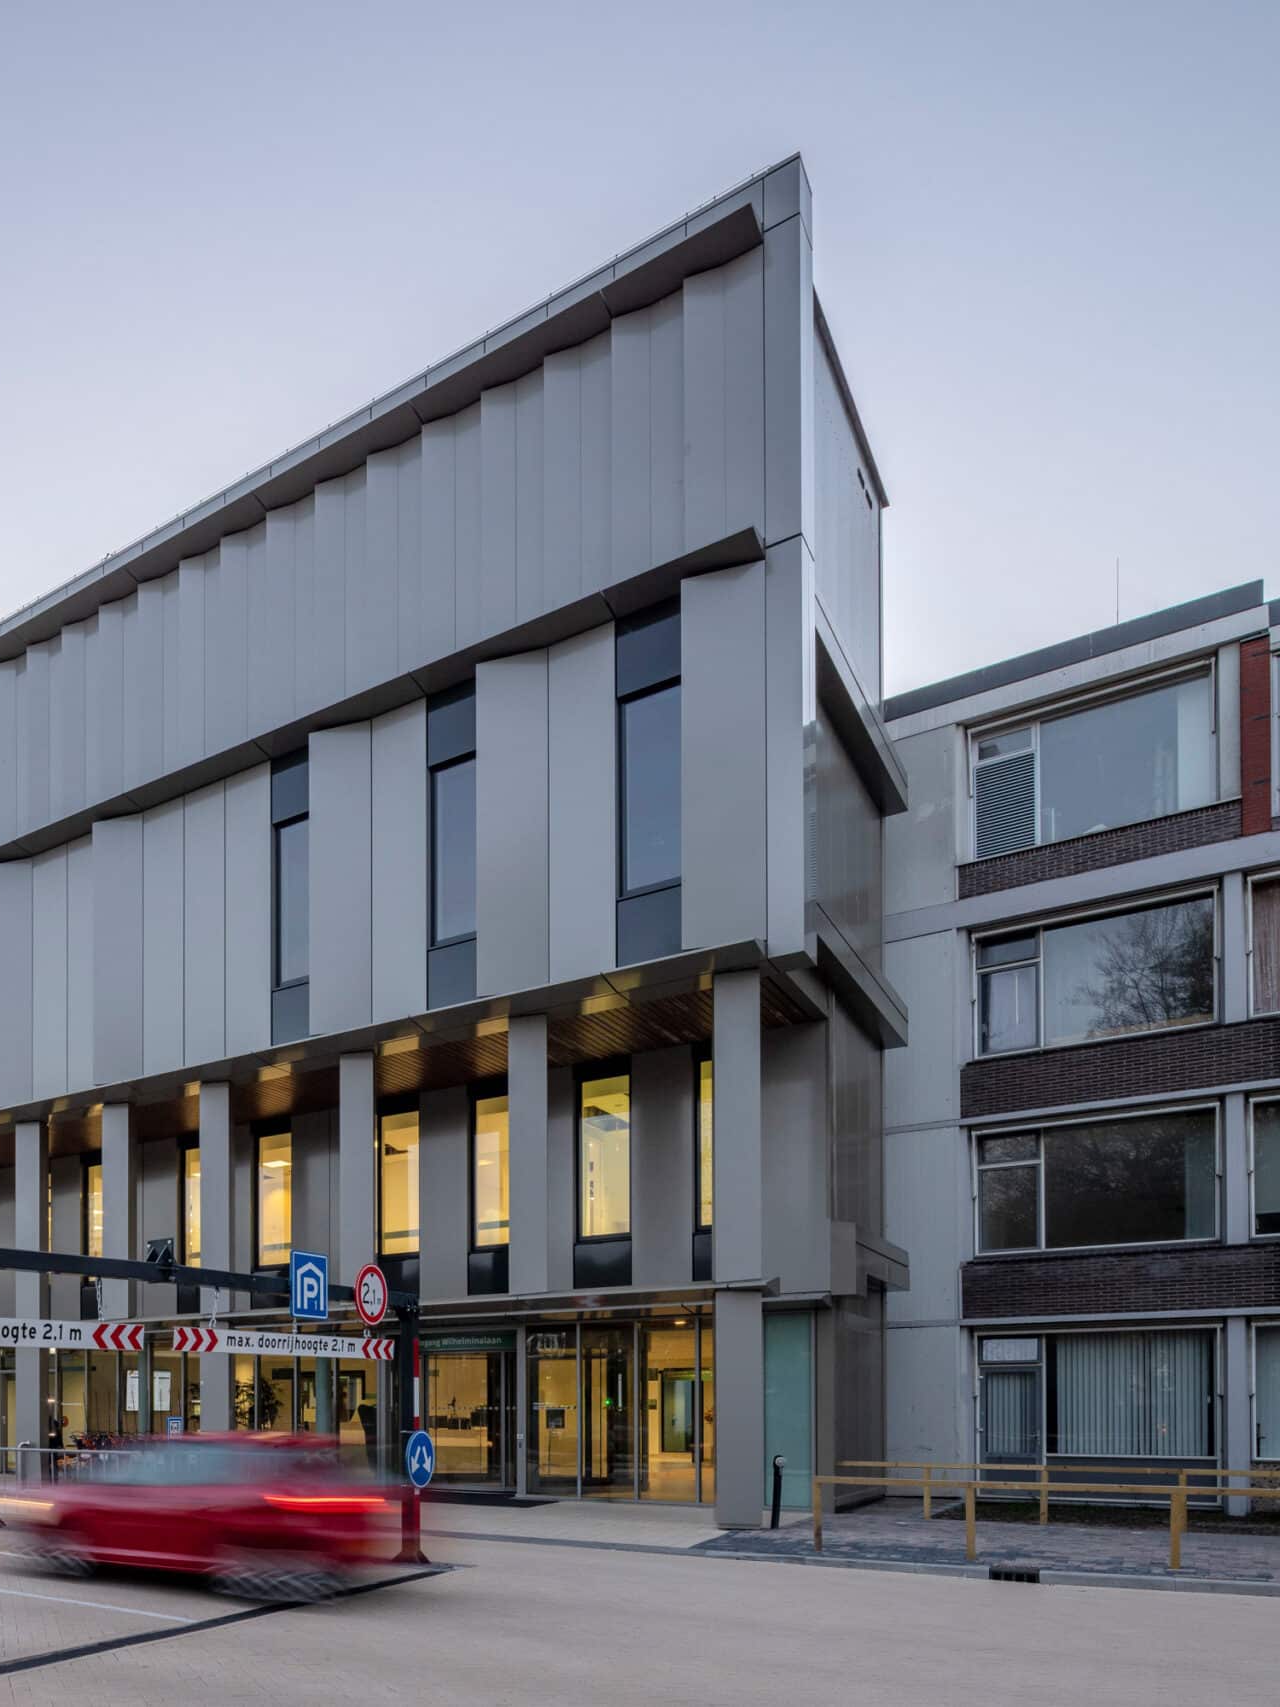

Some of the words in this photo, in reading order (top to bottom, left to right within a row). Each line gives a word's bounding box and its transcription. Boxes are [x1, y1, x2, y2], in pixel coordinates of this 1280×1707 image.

[69, 1328, 82, 1341] m
[226, 1335, 254, 1348] max.
[258, 1334, 329, 1354] doorrijhoogte
[347, 1342, 356, 1352] m
